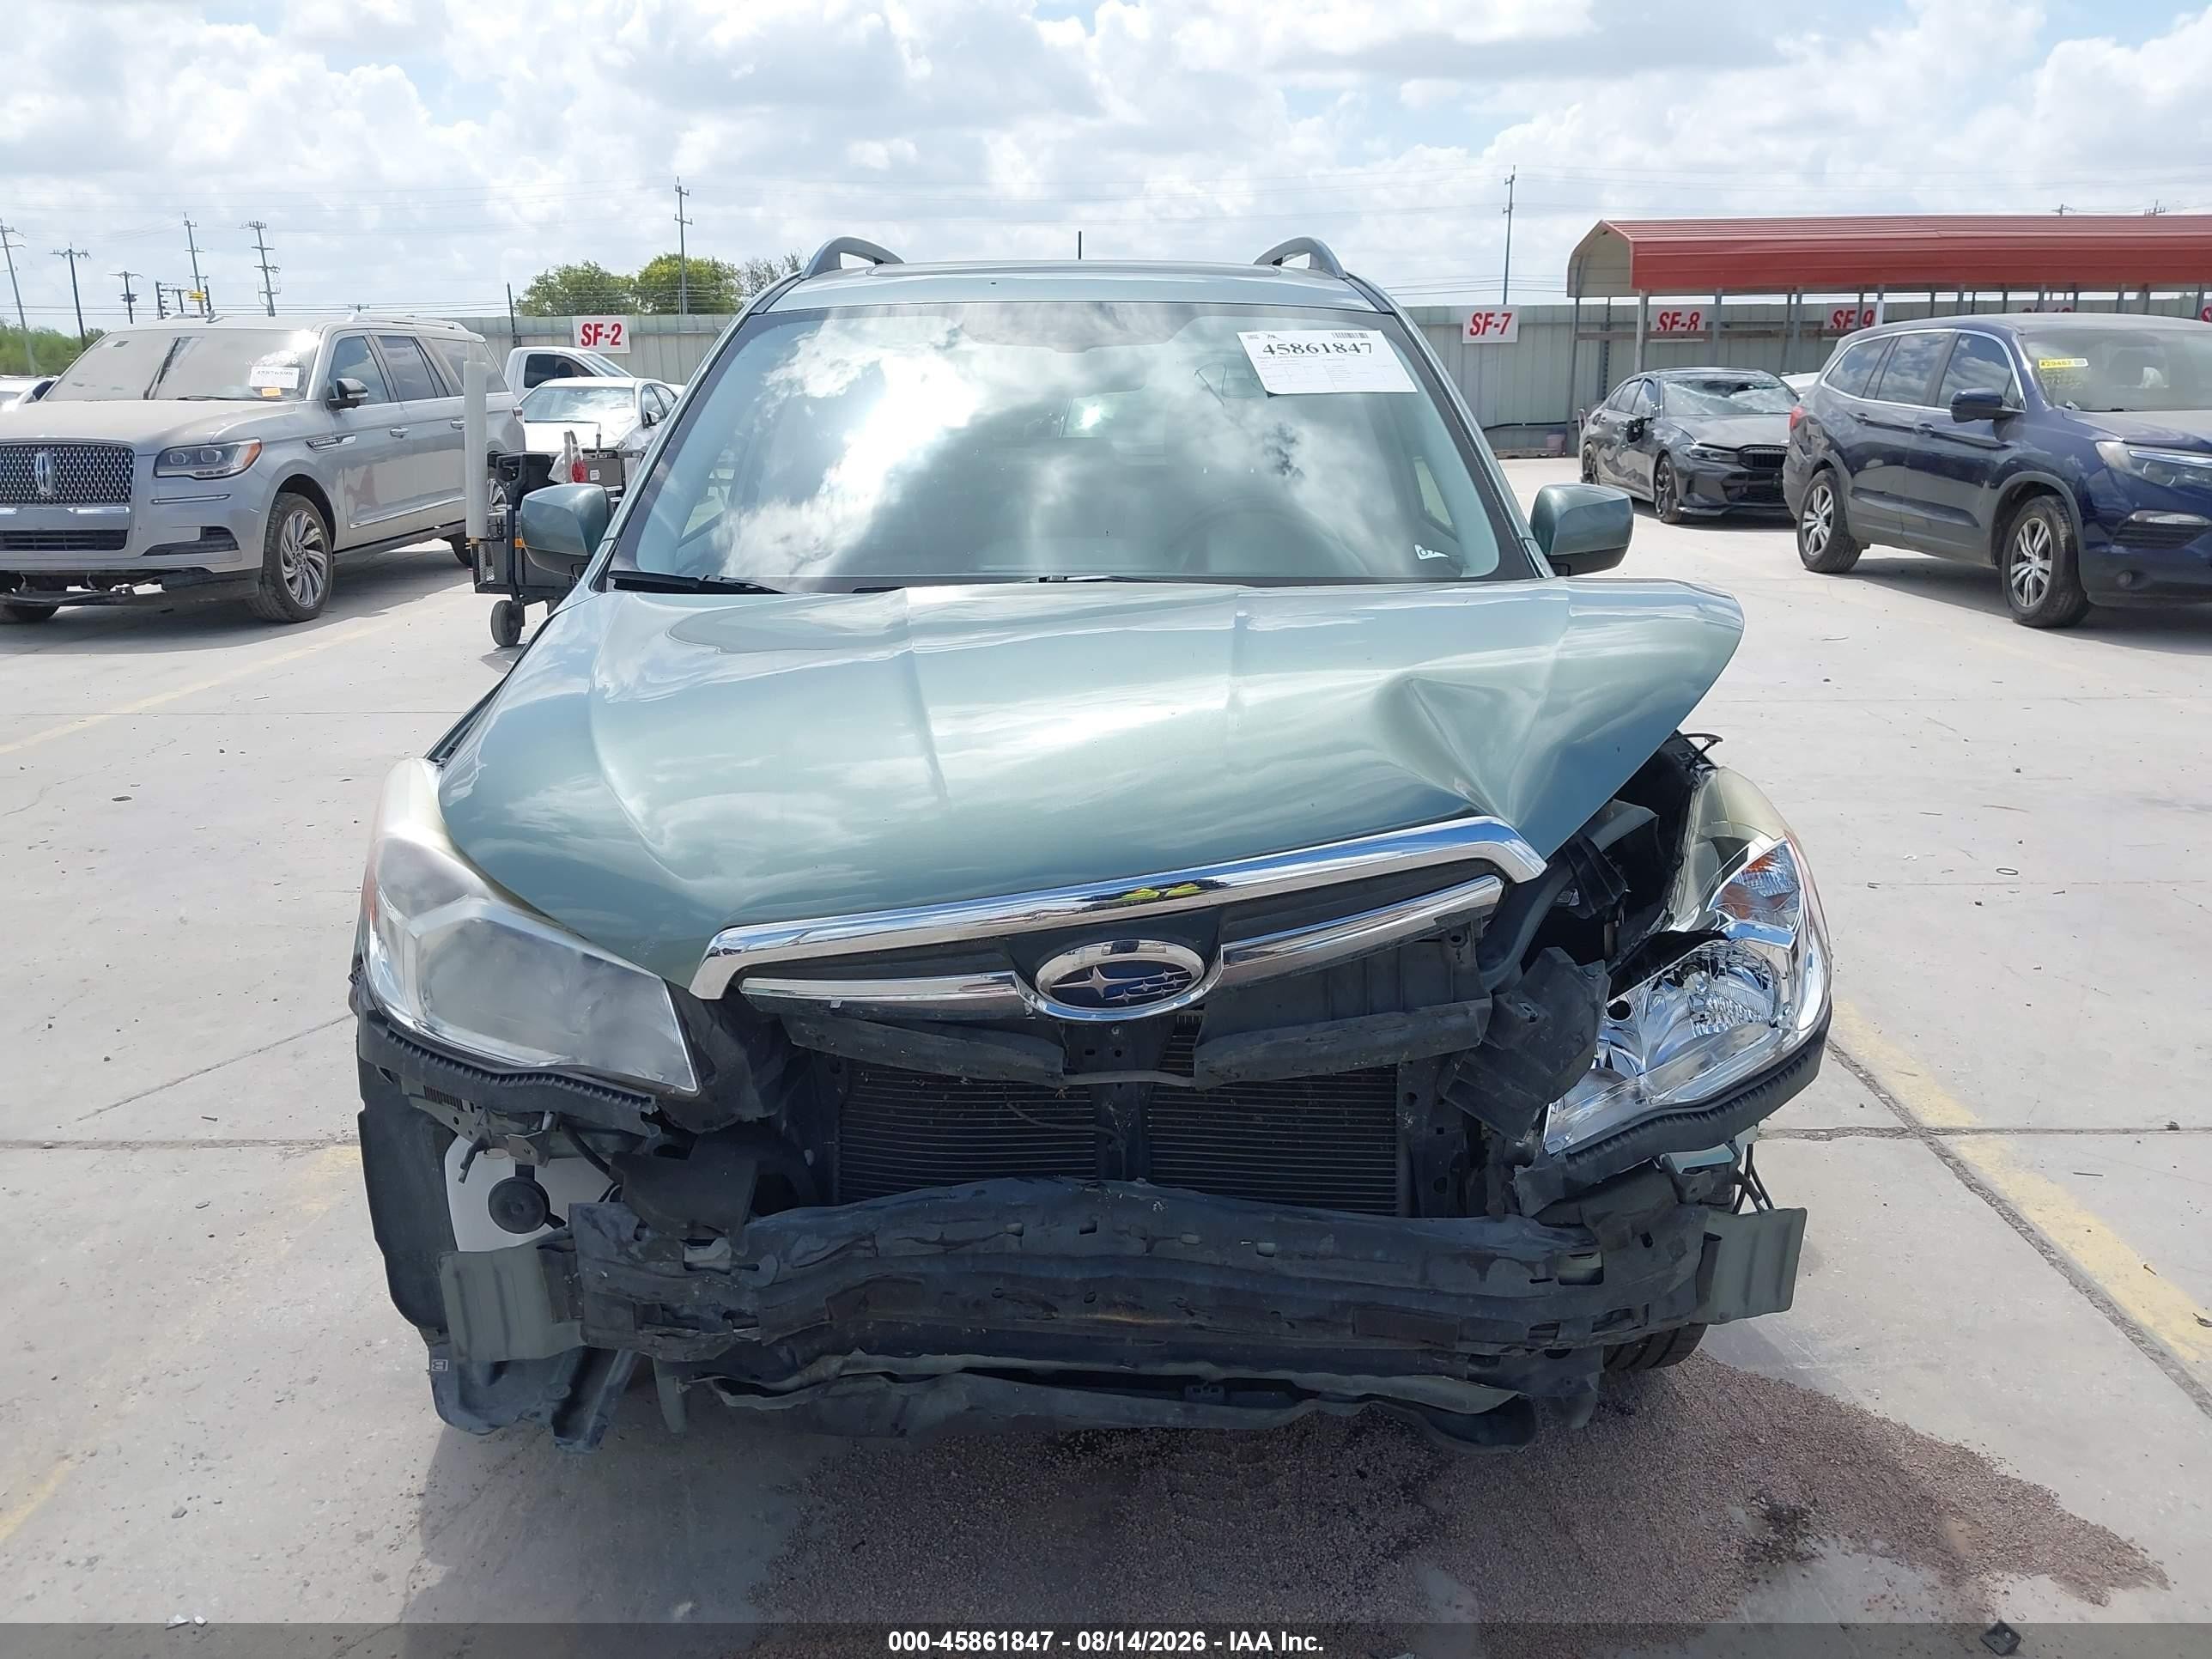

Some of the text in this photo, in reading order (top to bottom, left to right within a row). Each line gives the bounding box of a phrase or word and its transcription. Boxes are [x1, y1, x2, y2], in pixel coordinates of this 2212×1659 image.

[1469, 312, 1512, 336] SF-7
[1656, 311, 1700, 331] SF-8
[580, 322, 623, 346] SF-2
[1262, 343, 1372, 356] 45861847
